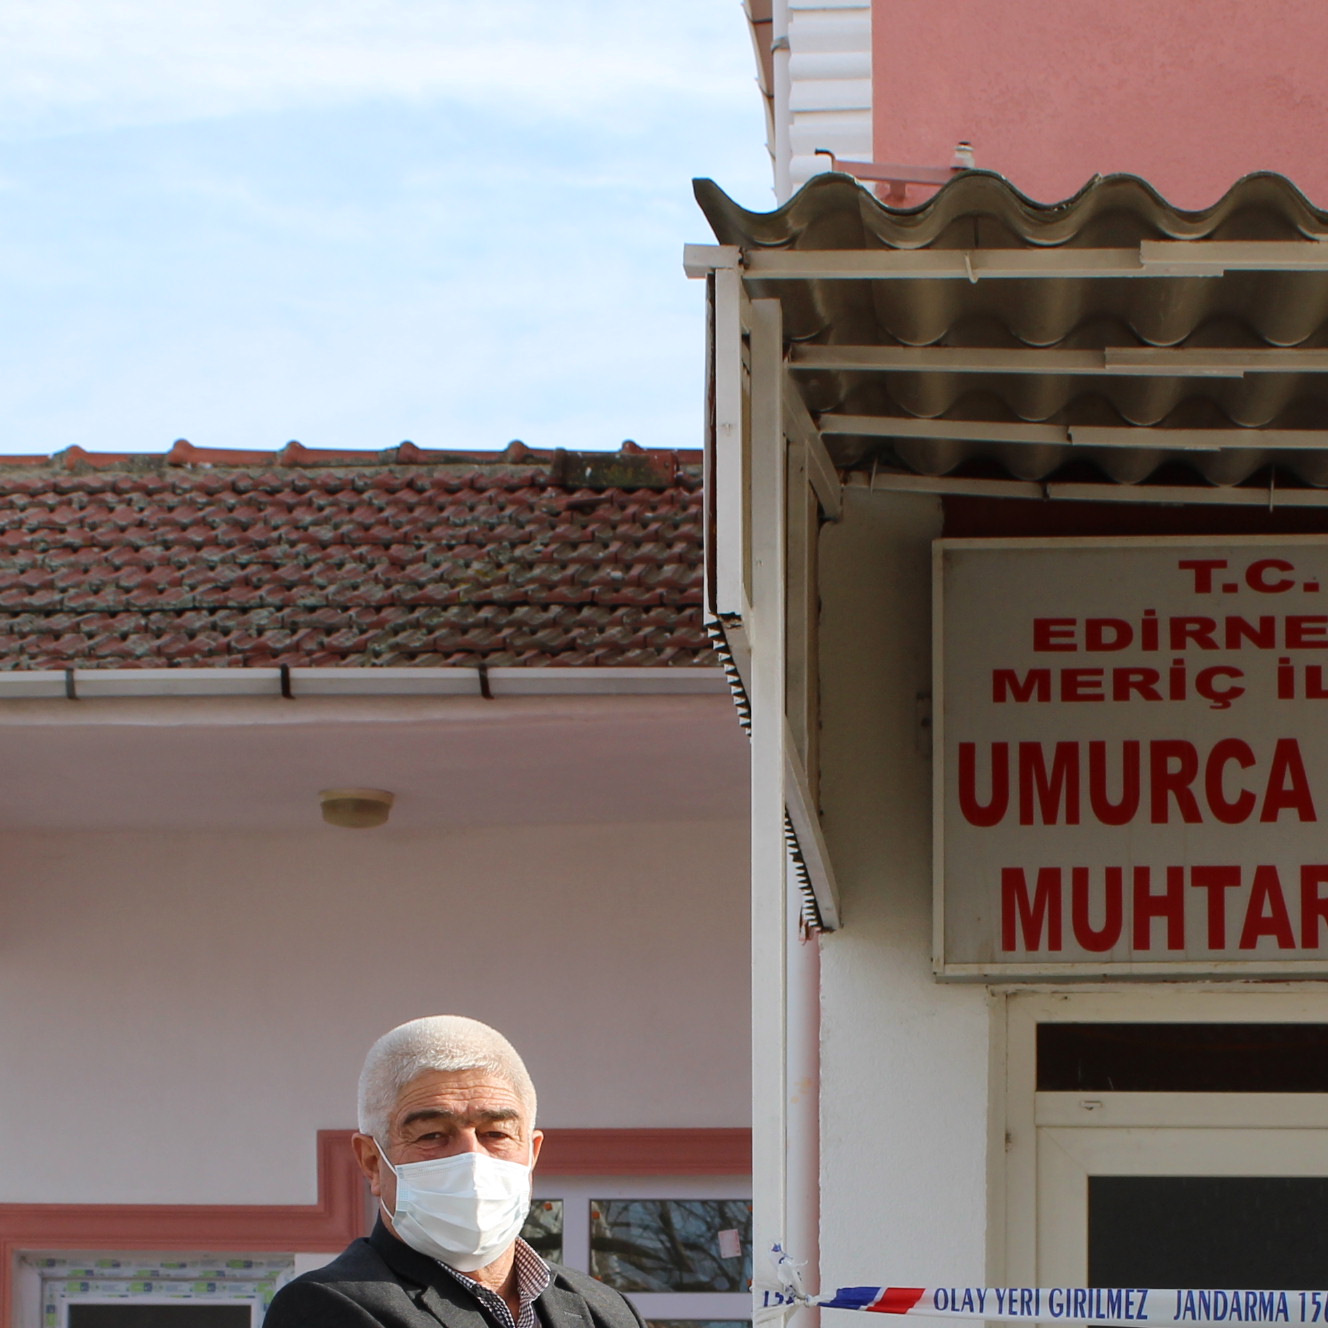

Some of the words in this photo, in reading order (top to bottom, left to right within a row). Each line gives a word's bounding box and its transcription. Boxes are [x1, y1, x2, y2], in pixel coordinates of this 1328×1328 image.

[1178, 558, 1320, 594] T.C.
[991, 657, 1246, 710] MERİÇ
[957, 737, 1318, 828] UMURCA
[933, 1287, 989, 1314] OLAY
[1173, 1289, 1290, 1323] JANDARMA
